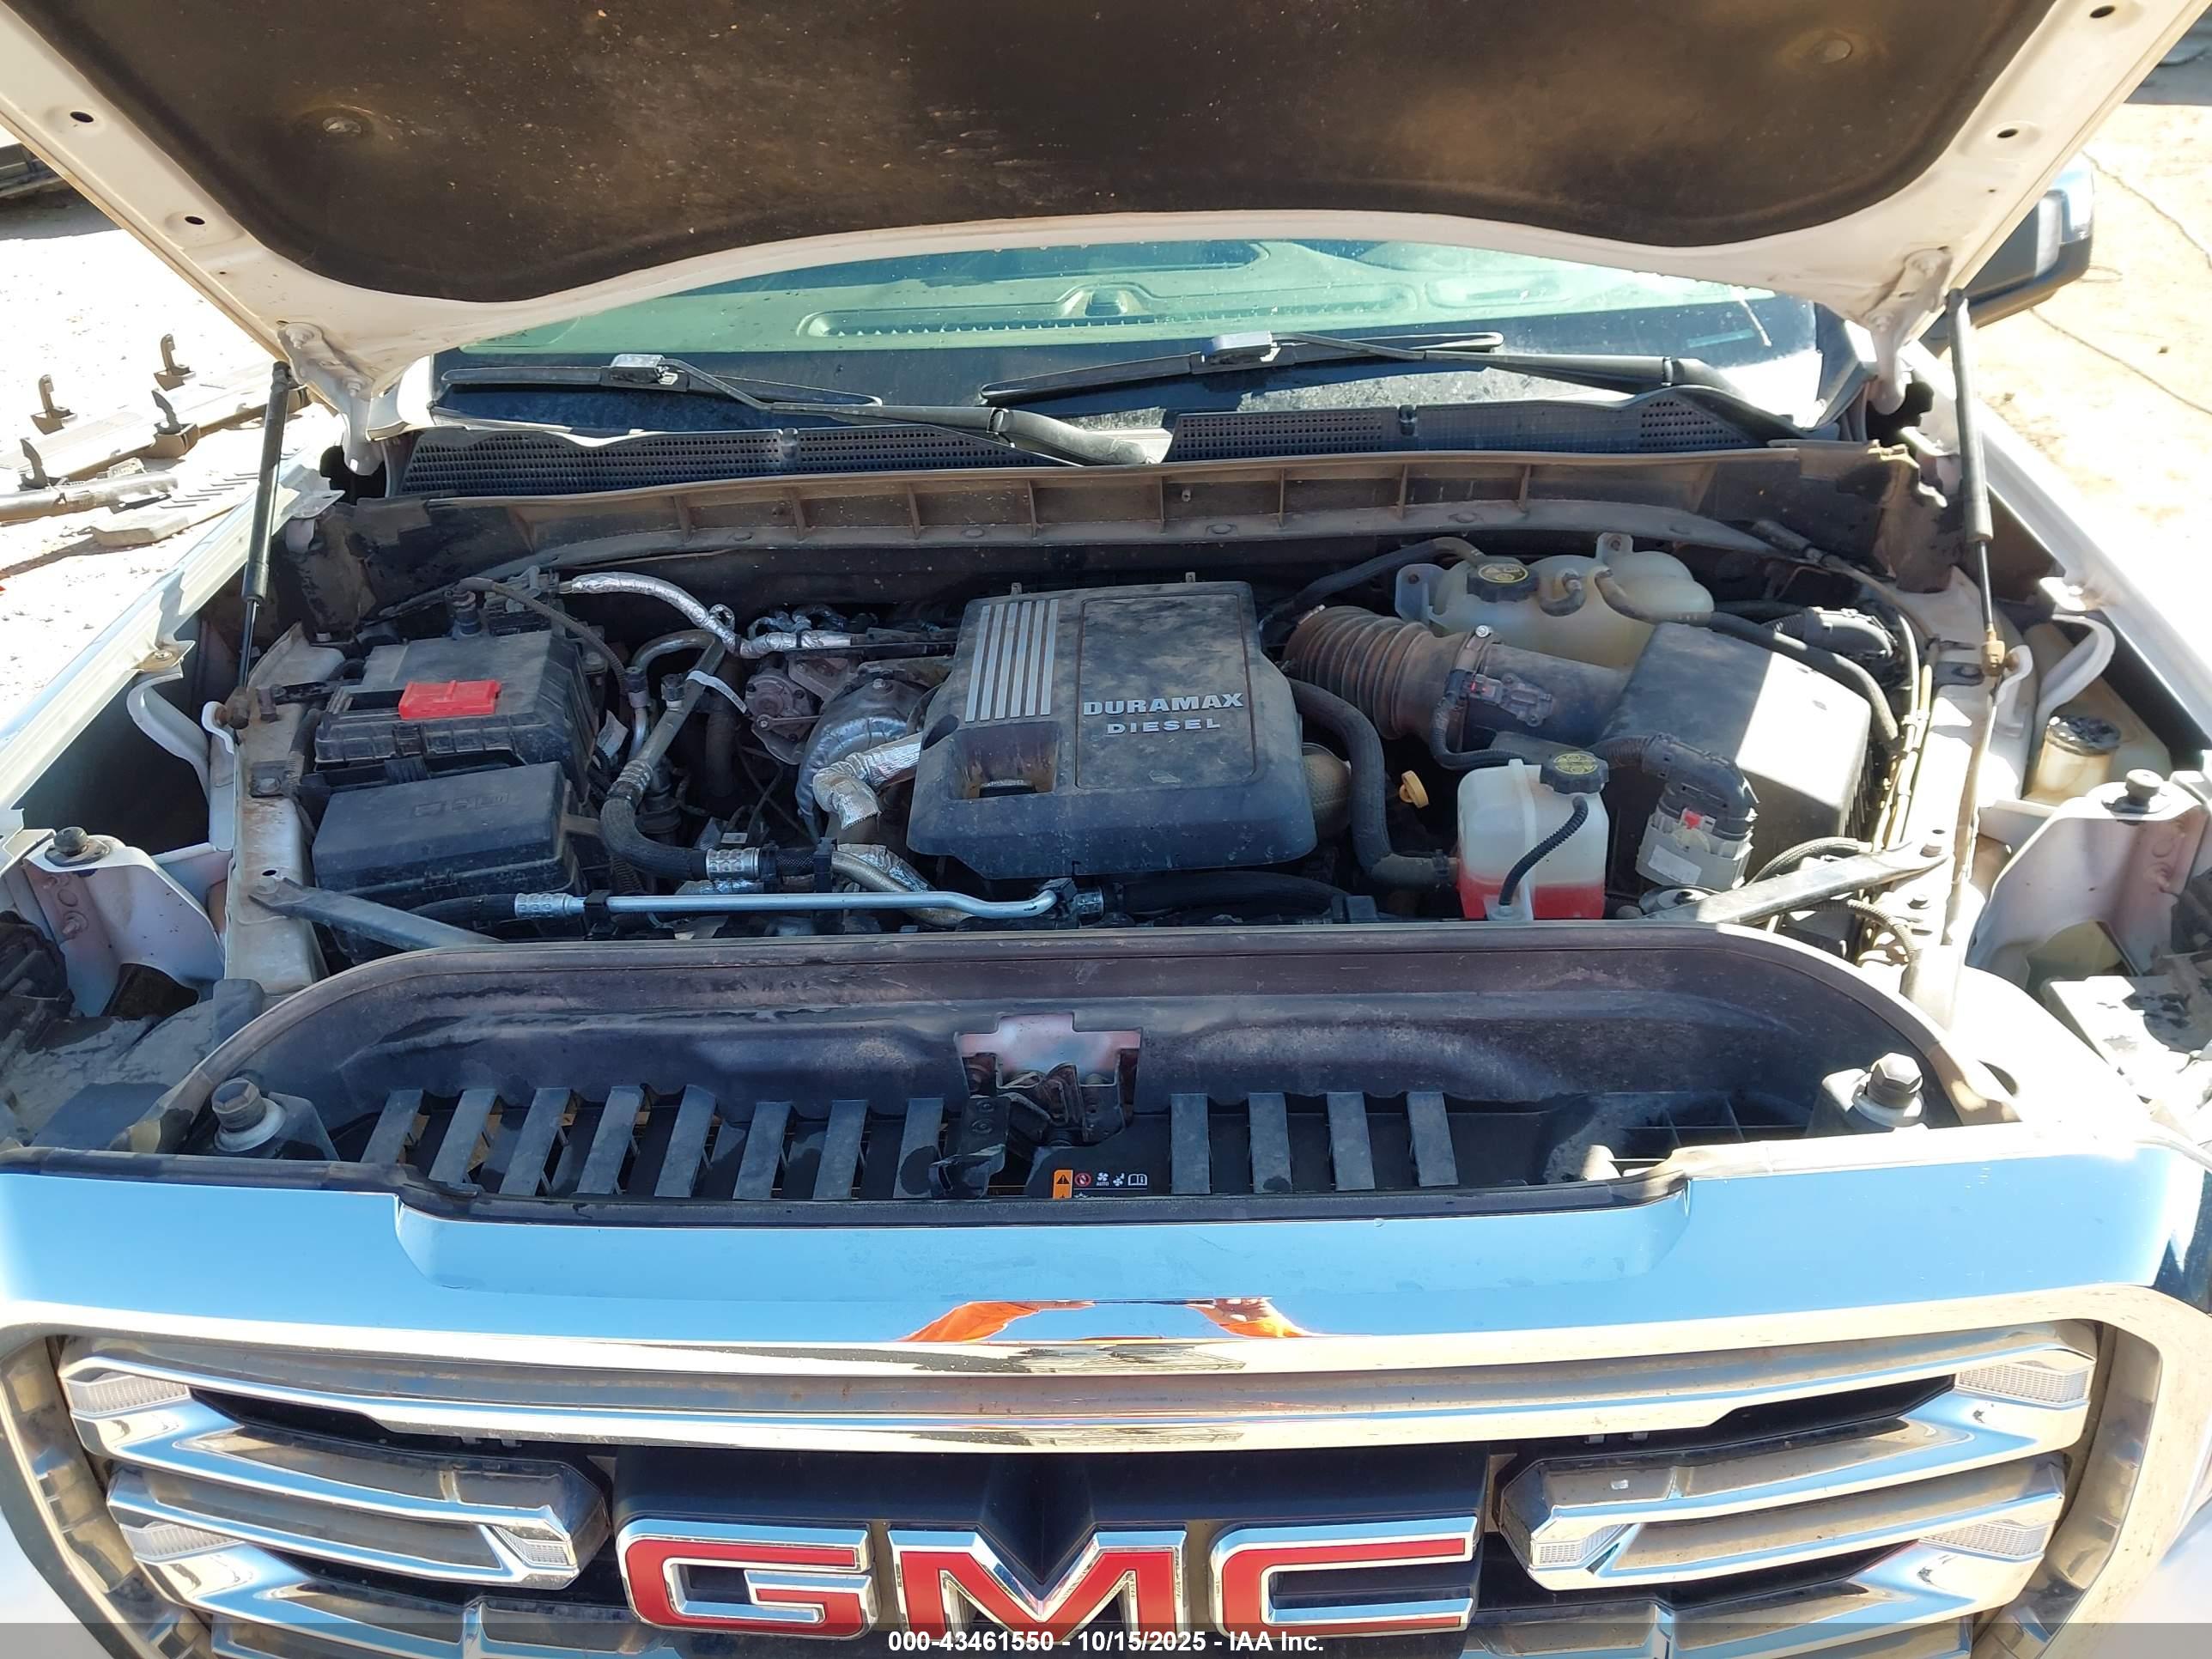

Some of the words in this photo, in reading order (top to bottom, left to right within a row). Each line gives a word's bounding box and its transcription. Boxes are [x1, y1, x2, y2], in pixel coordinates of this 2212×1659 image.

[1083, 692, 1244, 716] DURAMAX
[1107, 718, 1221, 735] DIESEL
[616, 1516, 1478, 1639] GMC
